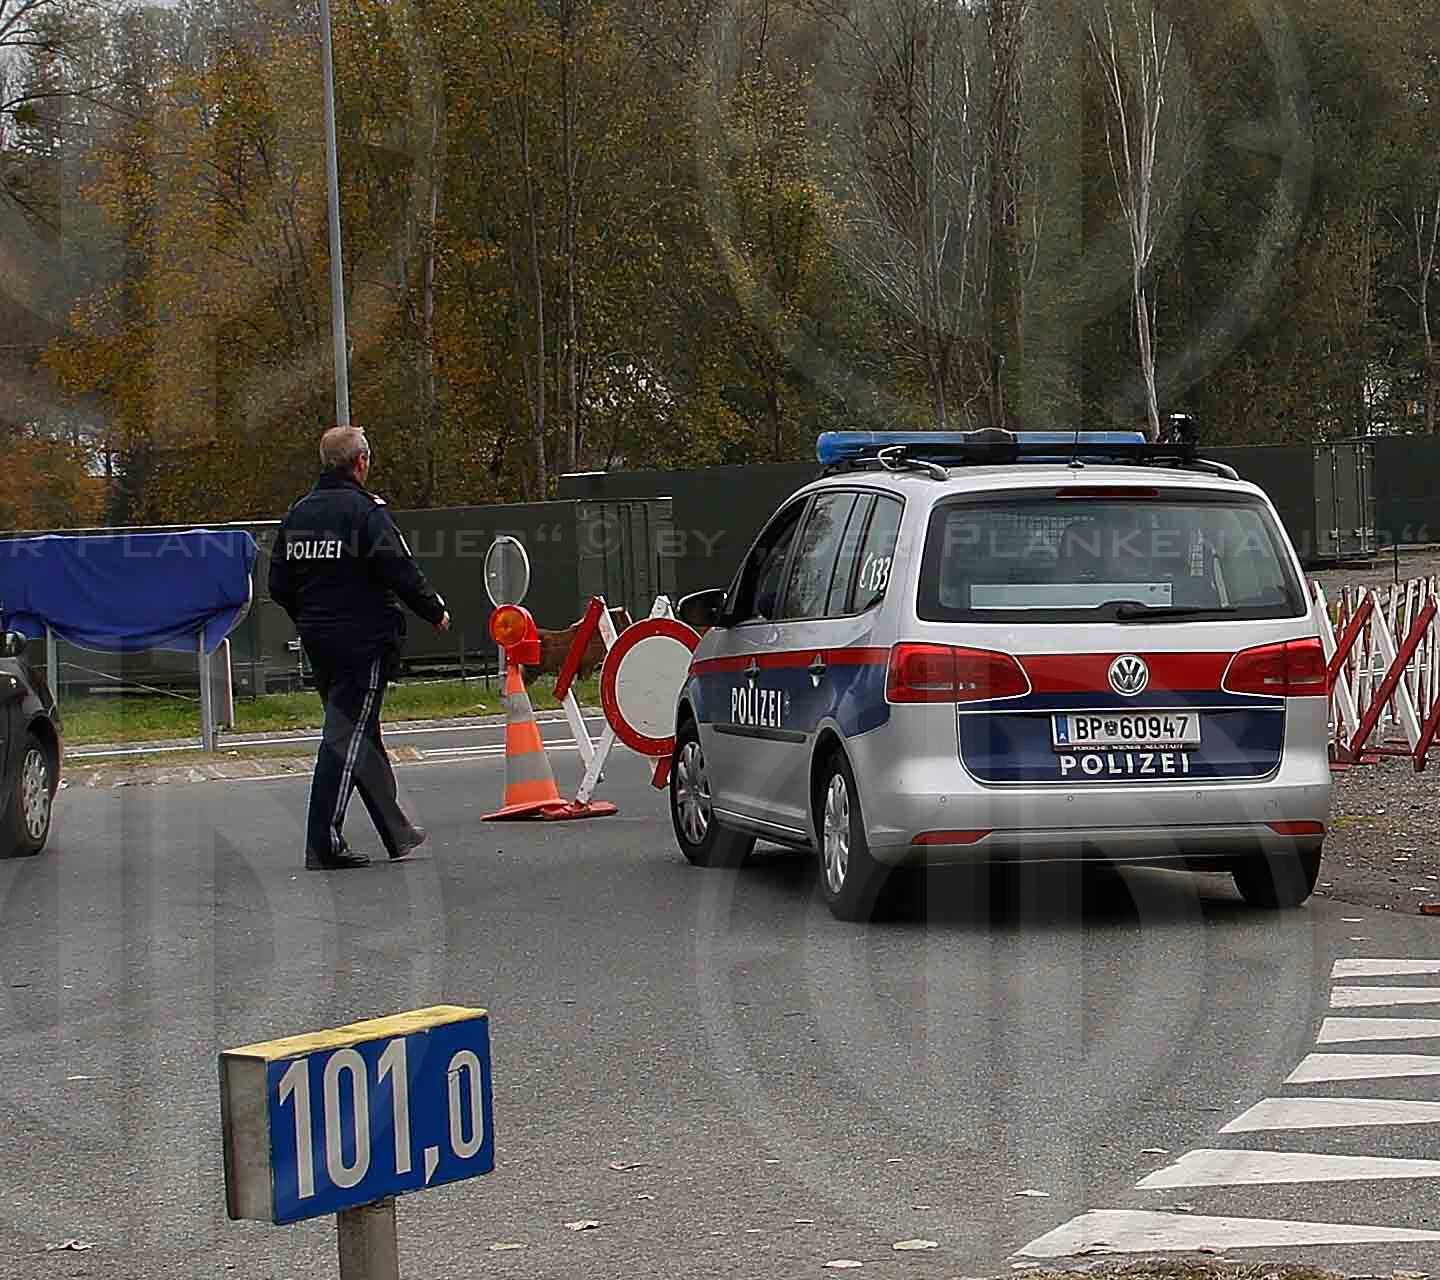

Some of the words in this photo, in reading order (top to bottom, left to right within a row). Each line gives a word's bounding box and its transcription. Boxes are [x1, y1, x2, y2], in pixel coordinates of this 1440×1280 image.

[286, 540, 342, 561] POLIZEI
[869, 556, 891, 591] 133
[731, 687, 782, 728] POLIZEI
[1076, 717, 1102, 740] BP
[1120, 716, 1189, 740] 60947
[1060, 752, 1190, 777] POLIZEI
[278, 1036, 484, 1200] 101,0
